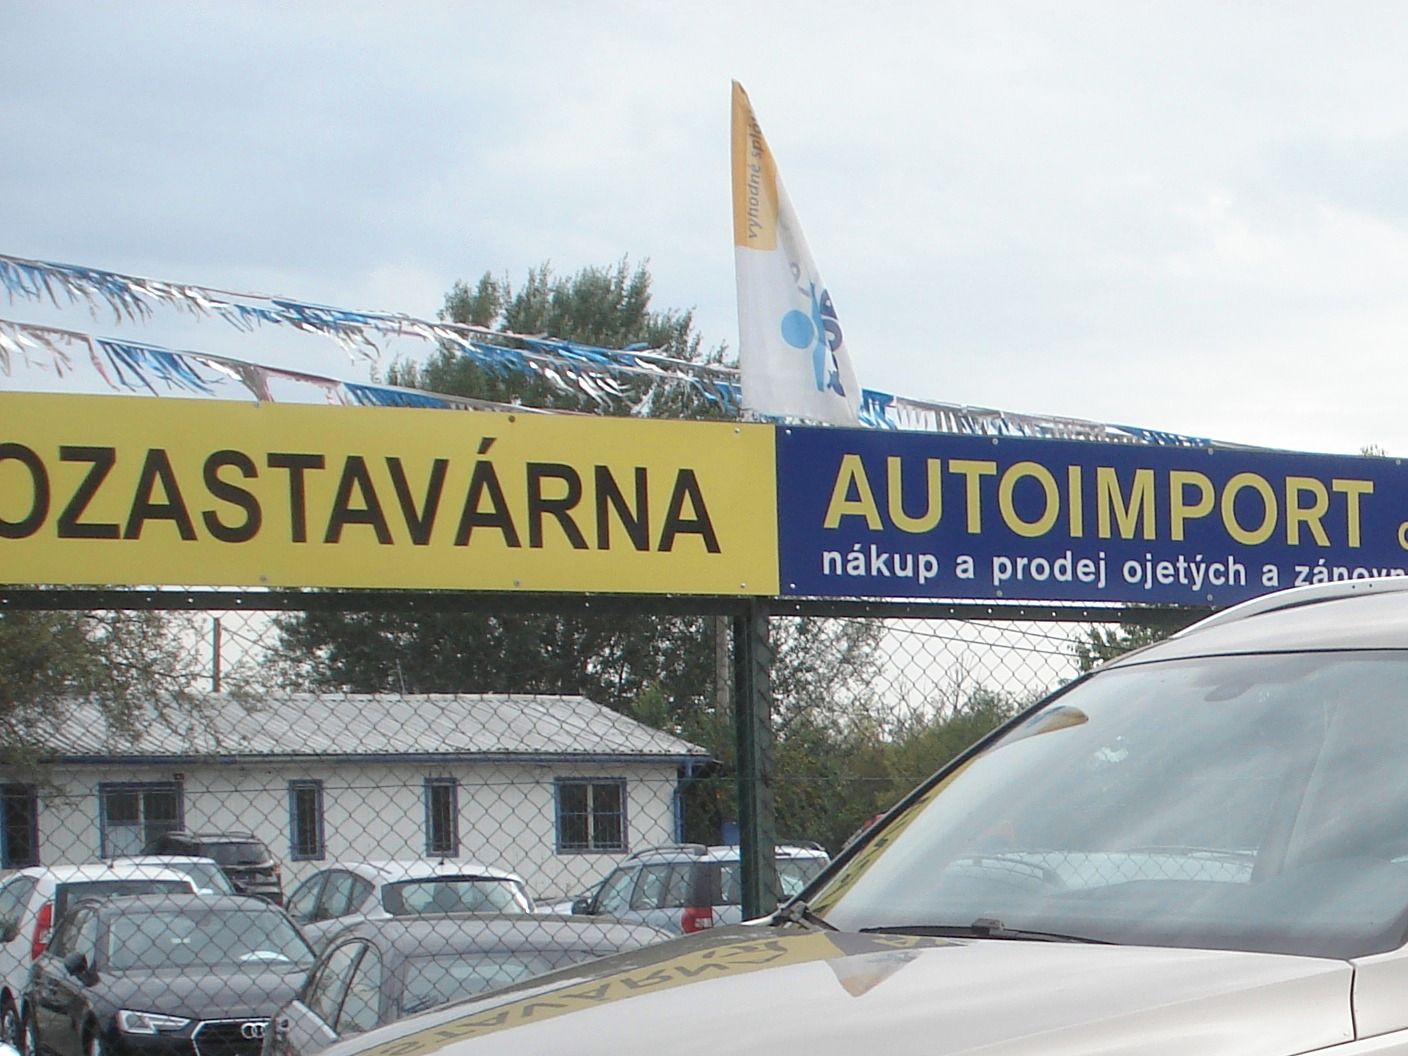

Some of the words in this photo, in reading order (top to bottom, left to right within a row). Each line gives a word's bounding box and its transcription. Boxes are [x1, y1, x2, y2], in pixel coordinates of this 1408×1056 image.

[0, 437, 722, 555] OZASTAVÁRNA
[823, 453, 1375, 548] AUTOIMPORT
[822, 543, 939, 584] nákup
[955, 554, 975, 579] a
[992, 550, 1106, 589] prodej
[1122, 552, 1246, 591] ojetých
[1261, 564, 1279, 587] a
